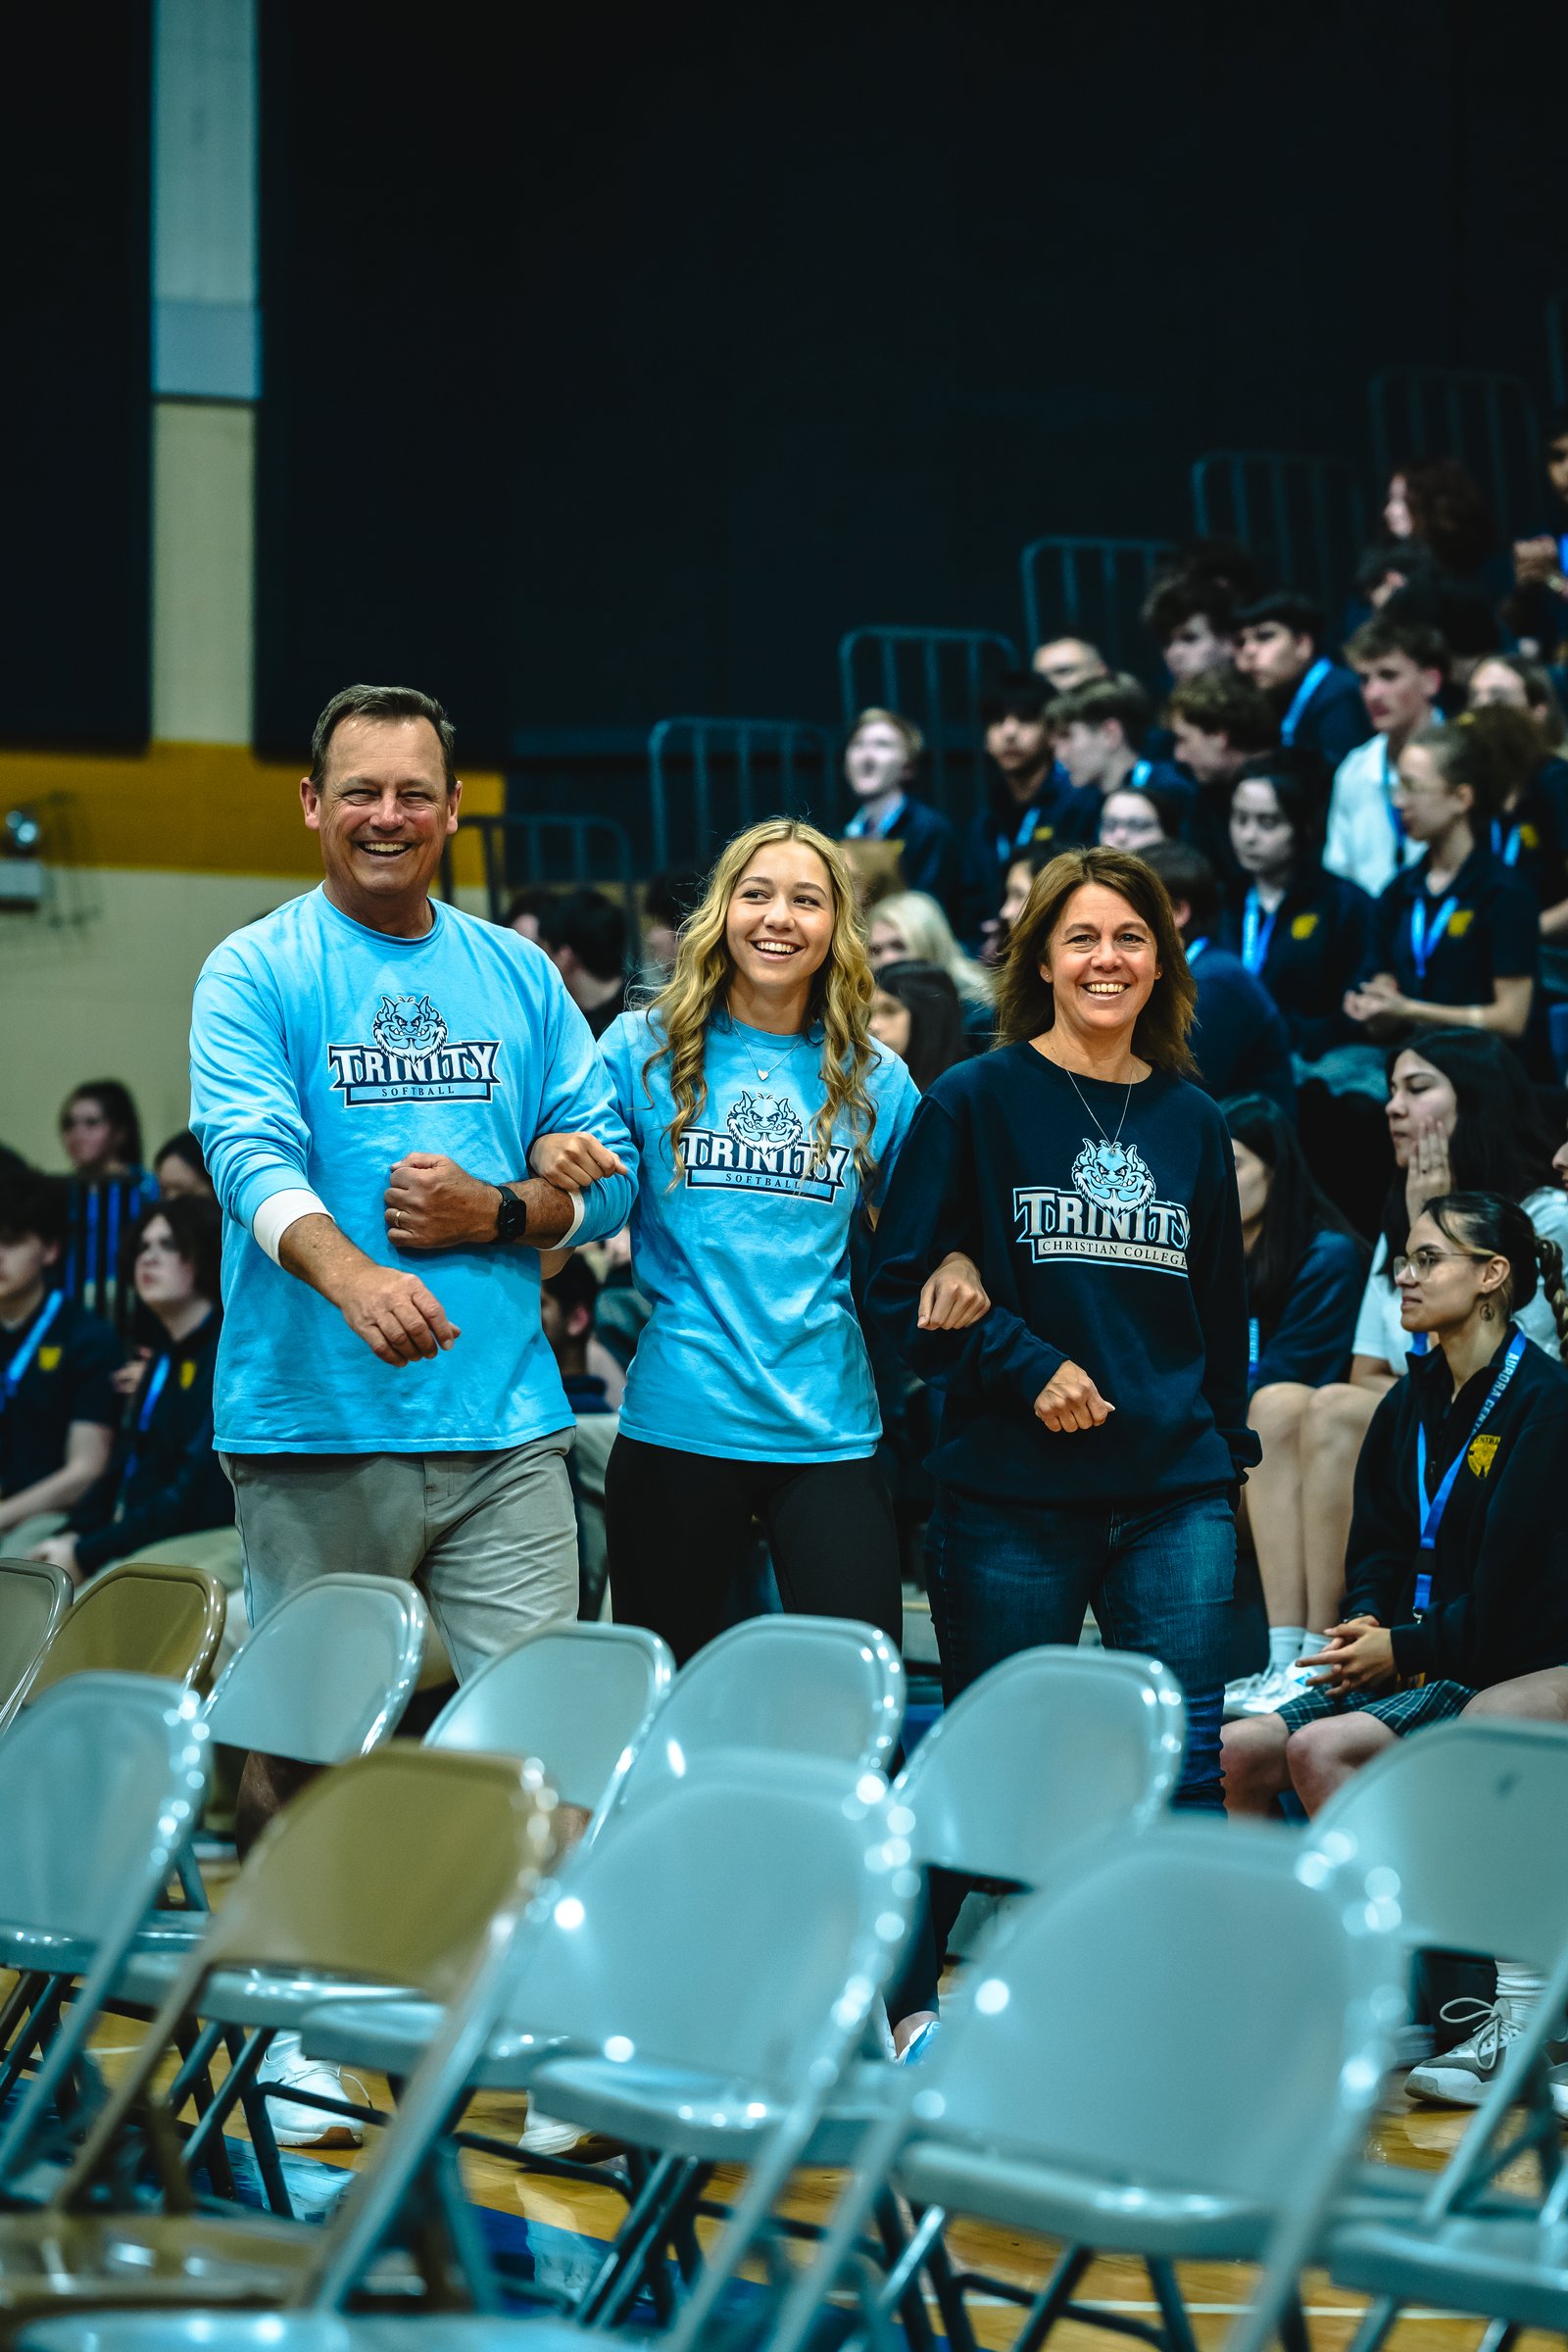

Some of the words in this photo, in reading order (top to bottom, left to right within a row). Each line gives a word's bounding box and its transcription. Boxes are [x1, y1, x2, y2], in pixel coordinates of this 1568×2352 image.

[331, 1045, 494, 1084] TRINITY
[382, 1086, 455, 1098] SOFTBALL
[679, 1133, 847, 1183] TRINITY
[725, 1173, 801, 1190] SOFTBALL
[1042, 1240, 1118, 1255] CHRISTIAN
[1490, 1351, 1520, 1397] AURORA
[1471, 1398, 1495, 1436] CENT
